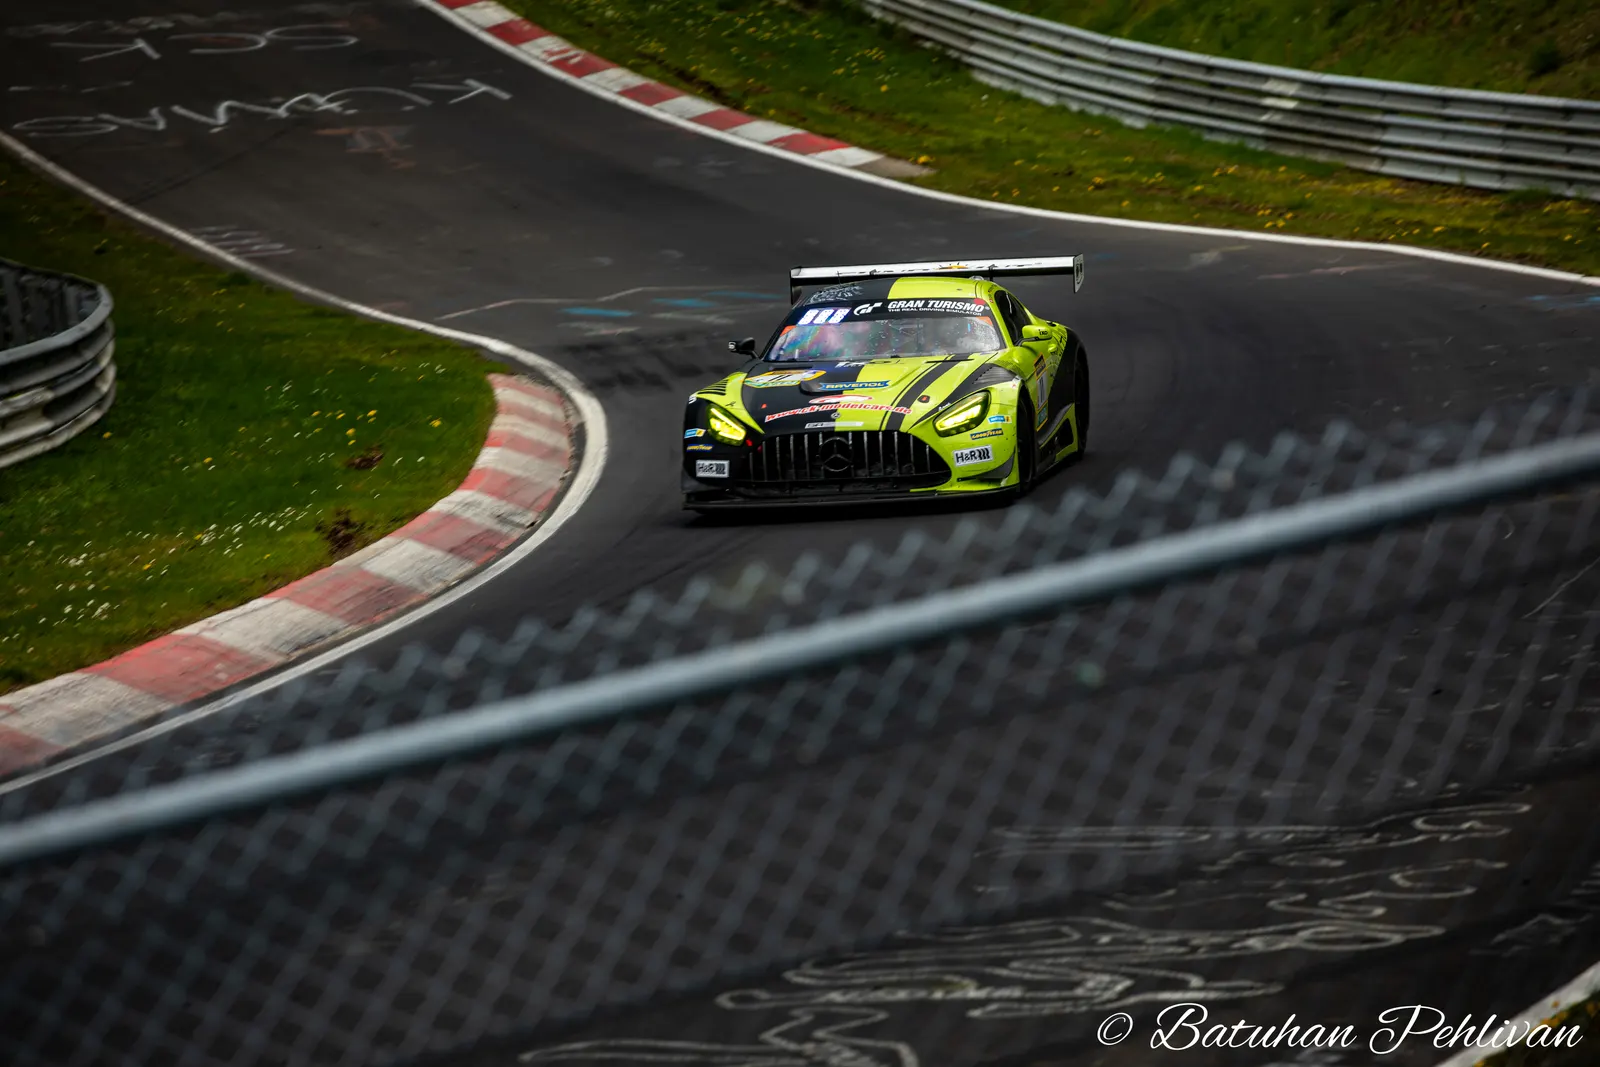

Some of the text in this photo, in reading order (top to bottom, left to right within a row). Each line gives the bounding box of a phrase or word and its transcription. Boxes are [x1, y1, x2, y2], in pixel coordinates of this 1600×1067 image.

[887, 300, 985, 312] GRAN TURISMO
[764, 402, 912, 422] www.ck-modelcars.de
